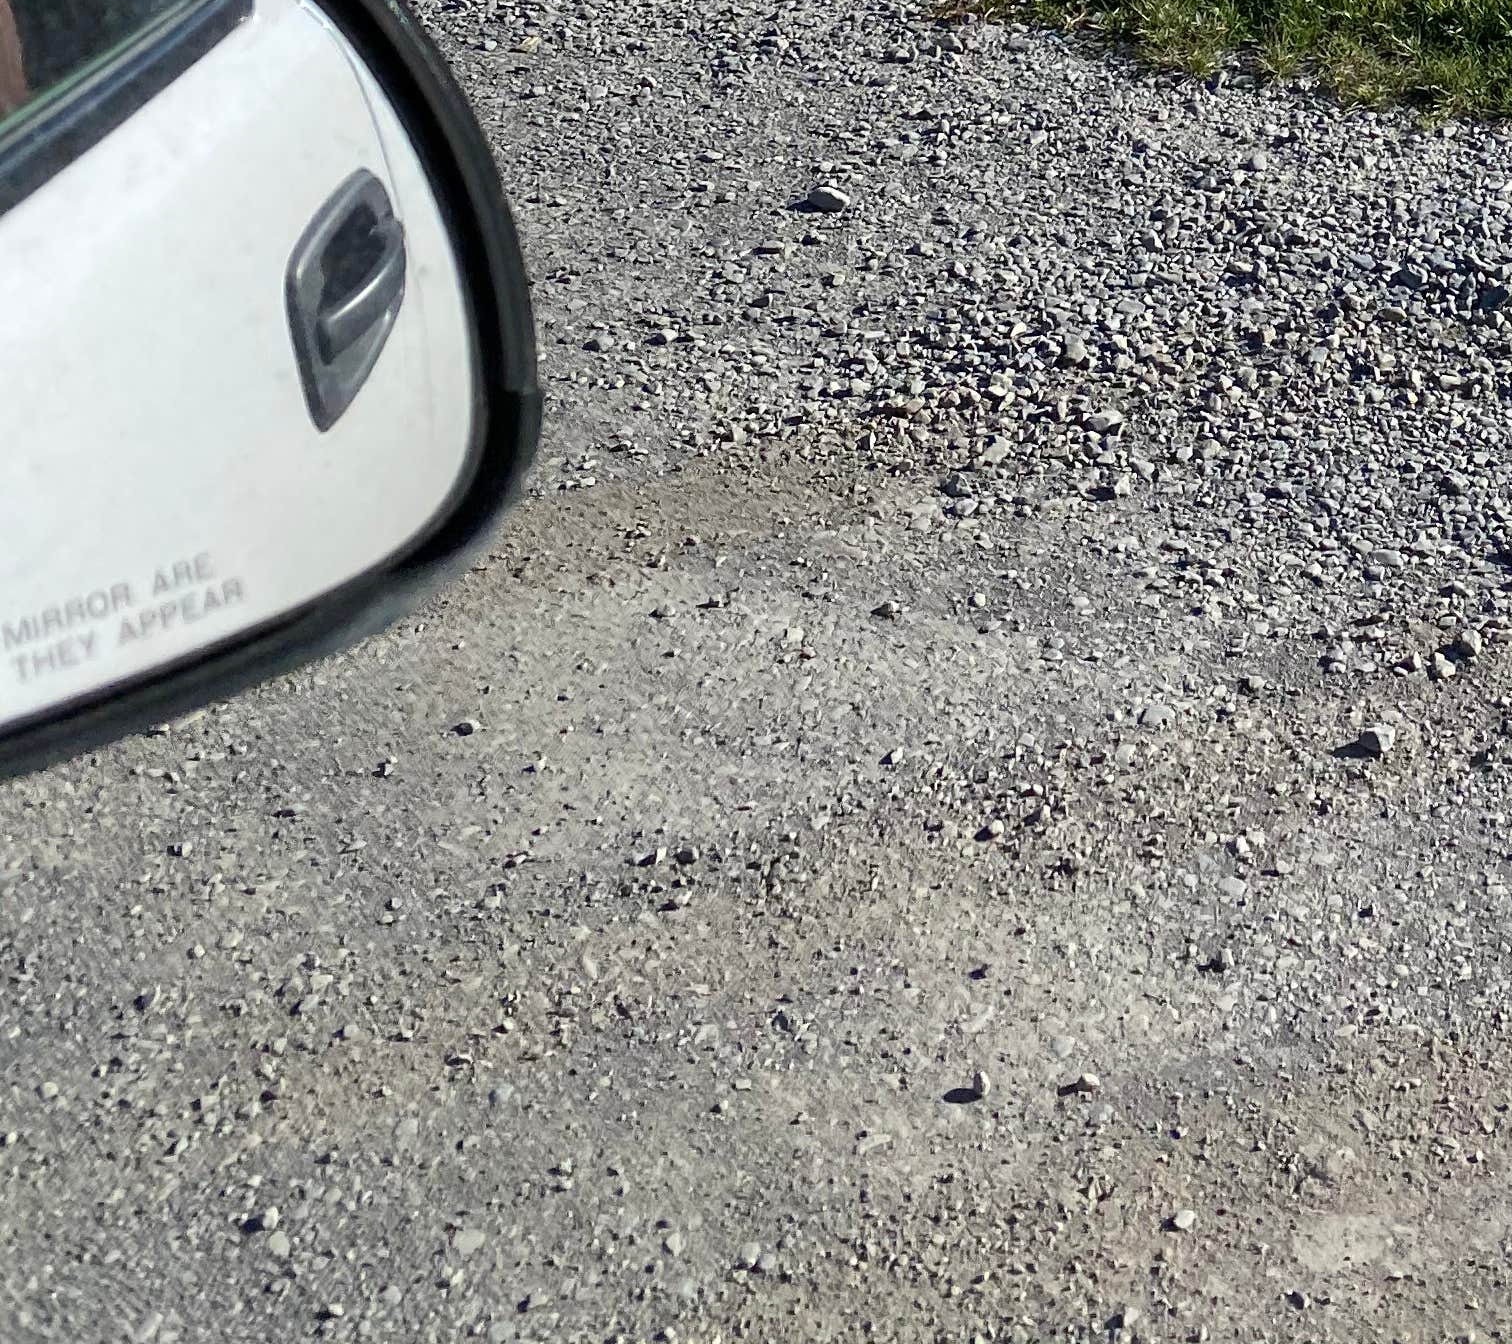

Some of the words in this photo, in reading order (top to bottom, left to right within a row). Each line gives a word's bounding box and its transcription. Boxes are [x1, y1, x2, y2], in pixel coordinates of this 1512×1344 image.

[1, 581, 132, 650] MIRROR
[152, 551, 214, 597] ARE
[12, 629, 97, 683] THEY
[116, 575, 244, 646] APPEAR
